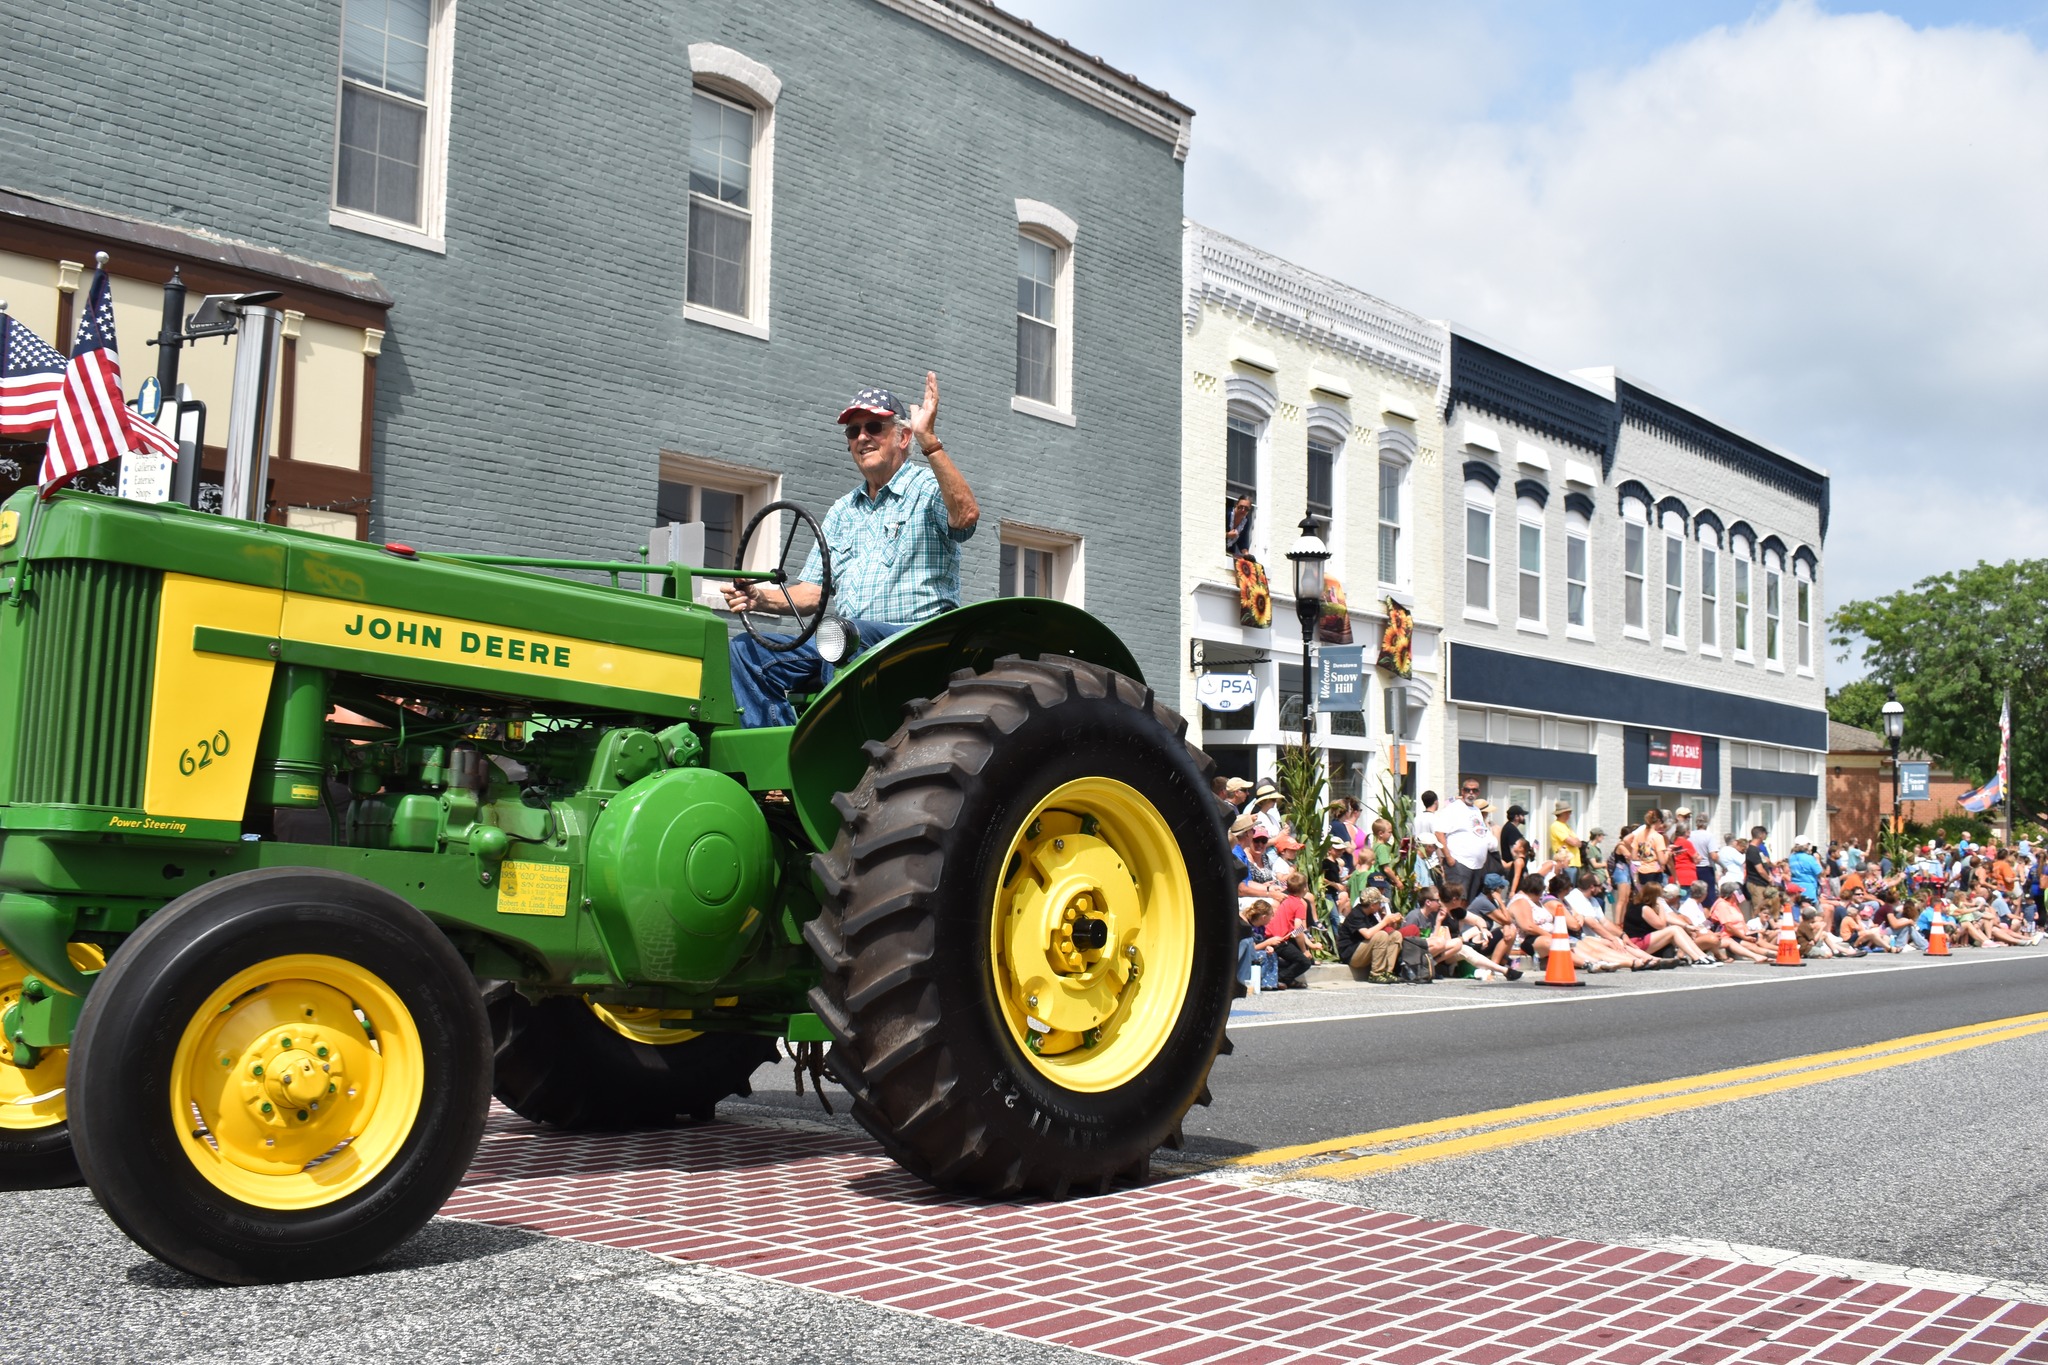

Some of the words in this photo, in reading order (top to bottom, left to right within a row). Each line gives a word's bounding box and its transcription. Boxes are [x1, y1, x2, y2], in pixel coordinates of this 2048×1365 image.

[345, 614, 442, 649] JOHN
[460, 631, 571, 668] DEERE
[1320, 659, 1330, 698] Welcome
[1331, 672, 1358, 682] Snow
[1221, 680, 1252, 693] PSA
[1335, 683, 1353, 693] Hill
[179, 729, 230, 777] 620
[1672, 744, 1685, 758] FOR
[1685, 745, 1700, 759] SALE
[109, 816, 142, 828] Power
[143, 818, 187, 833] Steering
[502, 861, 530, 871] JOHN
[534, 864, 568, 873] DEERE
